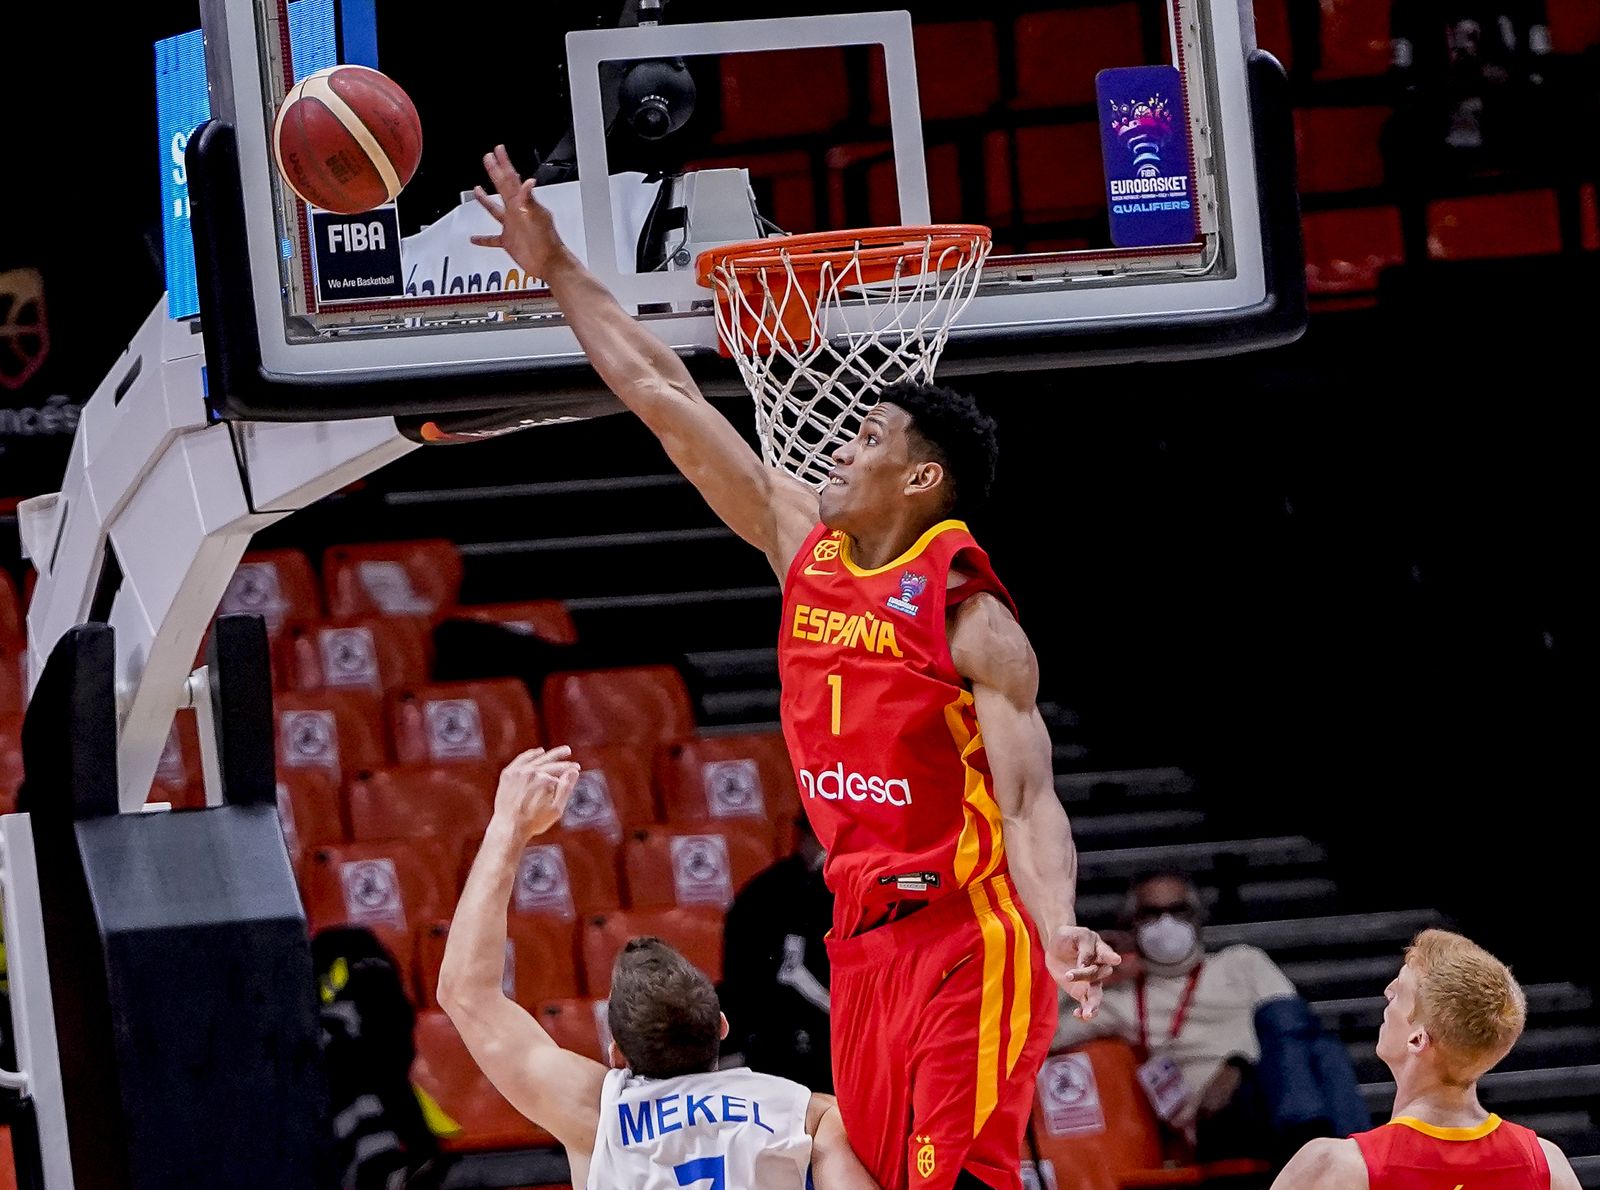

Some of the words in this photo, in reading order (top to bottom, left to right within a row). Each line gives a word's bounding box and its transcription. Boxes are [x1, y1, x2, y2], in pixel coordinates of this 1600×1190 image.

[1110, 176, 1188, 195] EUROBASKET
[1113, 200, 1191, 214] QUALIFIERS
[327, 221, 386, 253] FIBA
[328, 278, 341, 289] We
[342, 277, 356, 288] Are
[356, 275, 395, 286] Basketball
[792, 604, 904, 658] ESPAÑA
[827, 674, 843, 736] 1
[799, 761, 913, 807] ndesa
[618, 1094, 775, 1146] MEKEL
